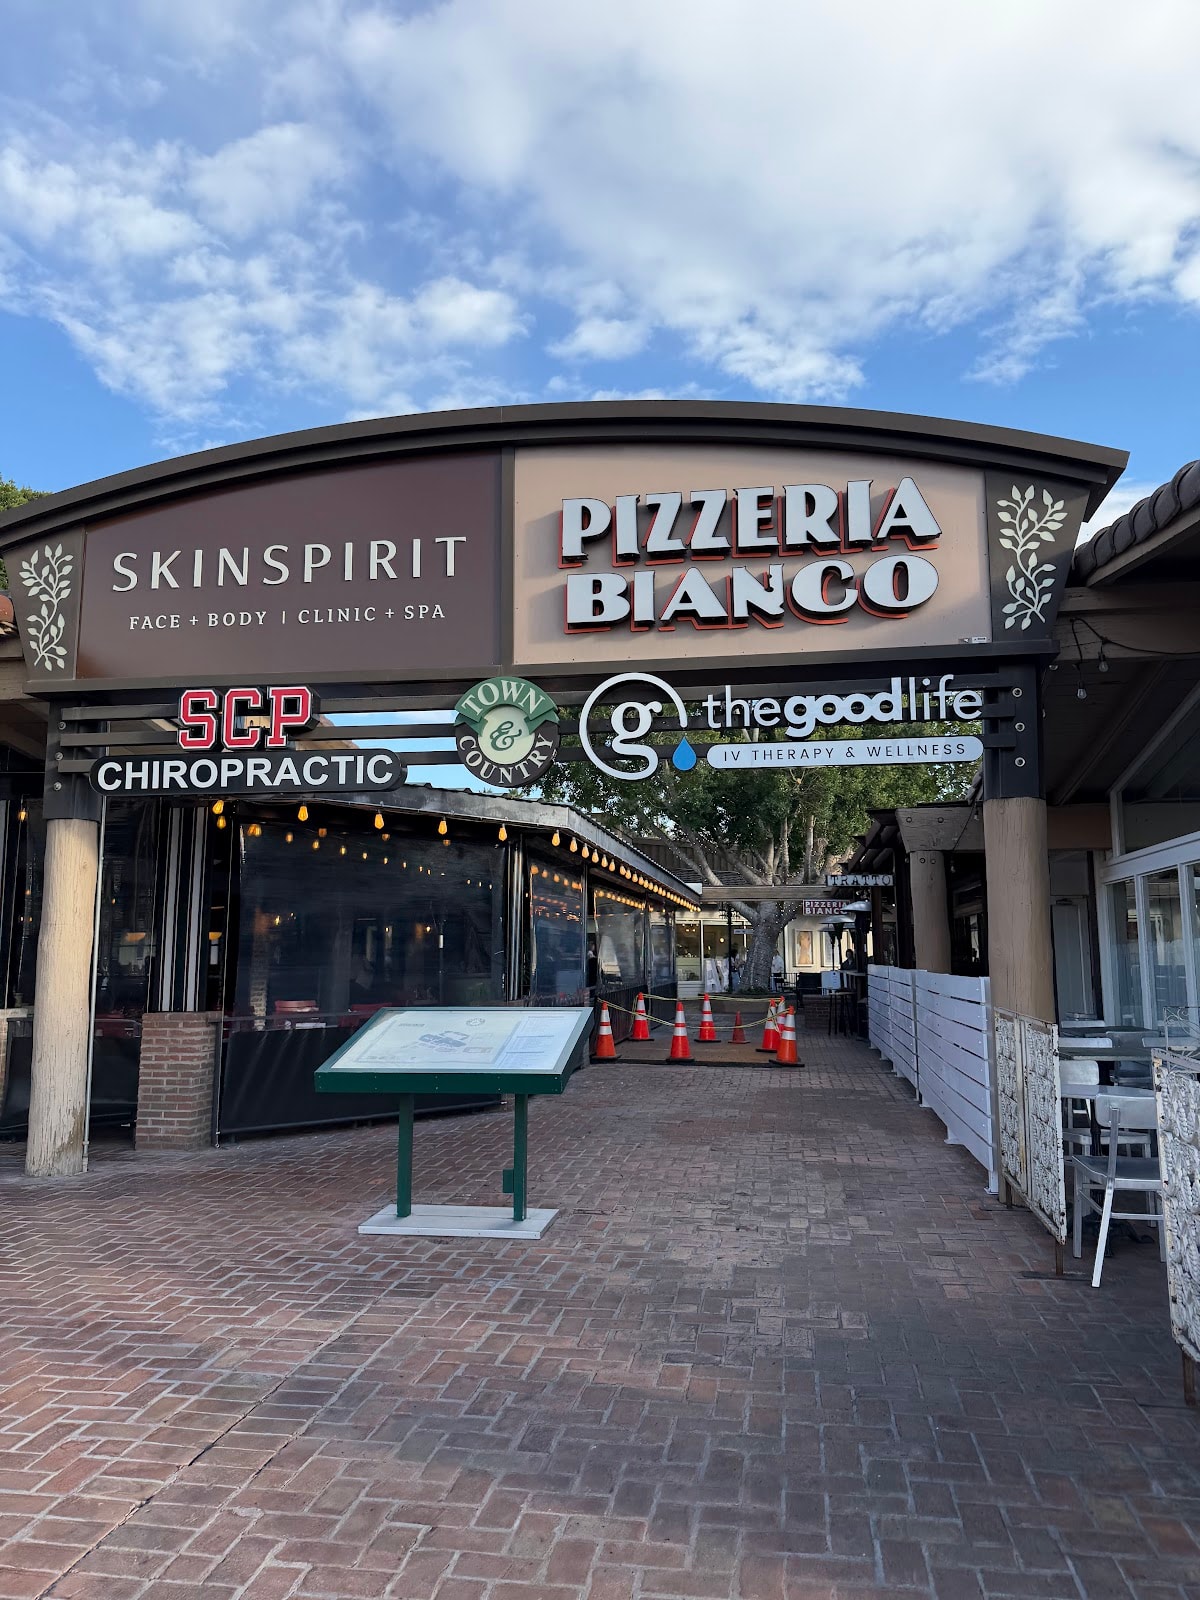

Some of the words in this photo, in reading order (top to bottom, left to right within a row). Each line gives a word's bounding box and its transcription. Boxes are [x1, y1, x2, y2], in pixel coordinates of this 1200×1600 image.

[560, 476, 942, 563] PIZZERIA
[112, 536, 467, 592] SKINSPIRIT
[565, 554, 939, 628] BIANCO
[129, 614, 181, 630] FACE
[207, 611, 267, 627] BODY
[298, 607, 376, 624] CLINIC
[404, 604, 446, 620] SPA
[461, 680, 545, 716] TOWN
[178, 686, 312, 749] SCP
[490, 720, 522, 752] &
[460, 733, 554, 784] COUNTRY
[723, 750, 741, 762] IV
[752, 746, 835, 761] THERAPY
[845, 746, 856, 758] &
[867, 743, 966, 758] WELLNESS
[97, 754, 394, 791] CHIROPRACTIC
[832, 875, 891, 886] TRATTO
